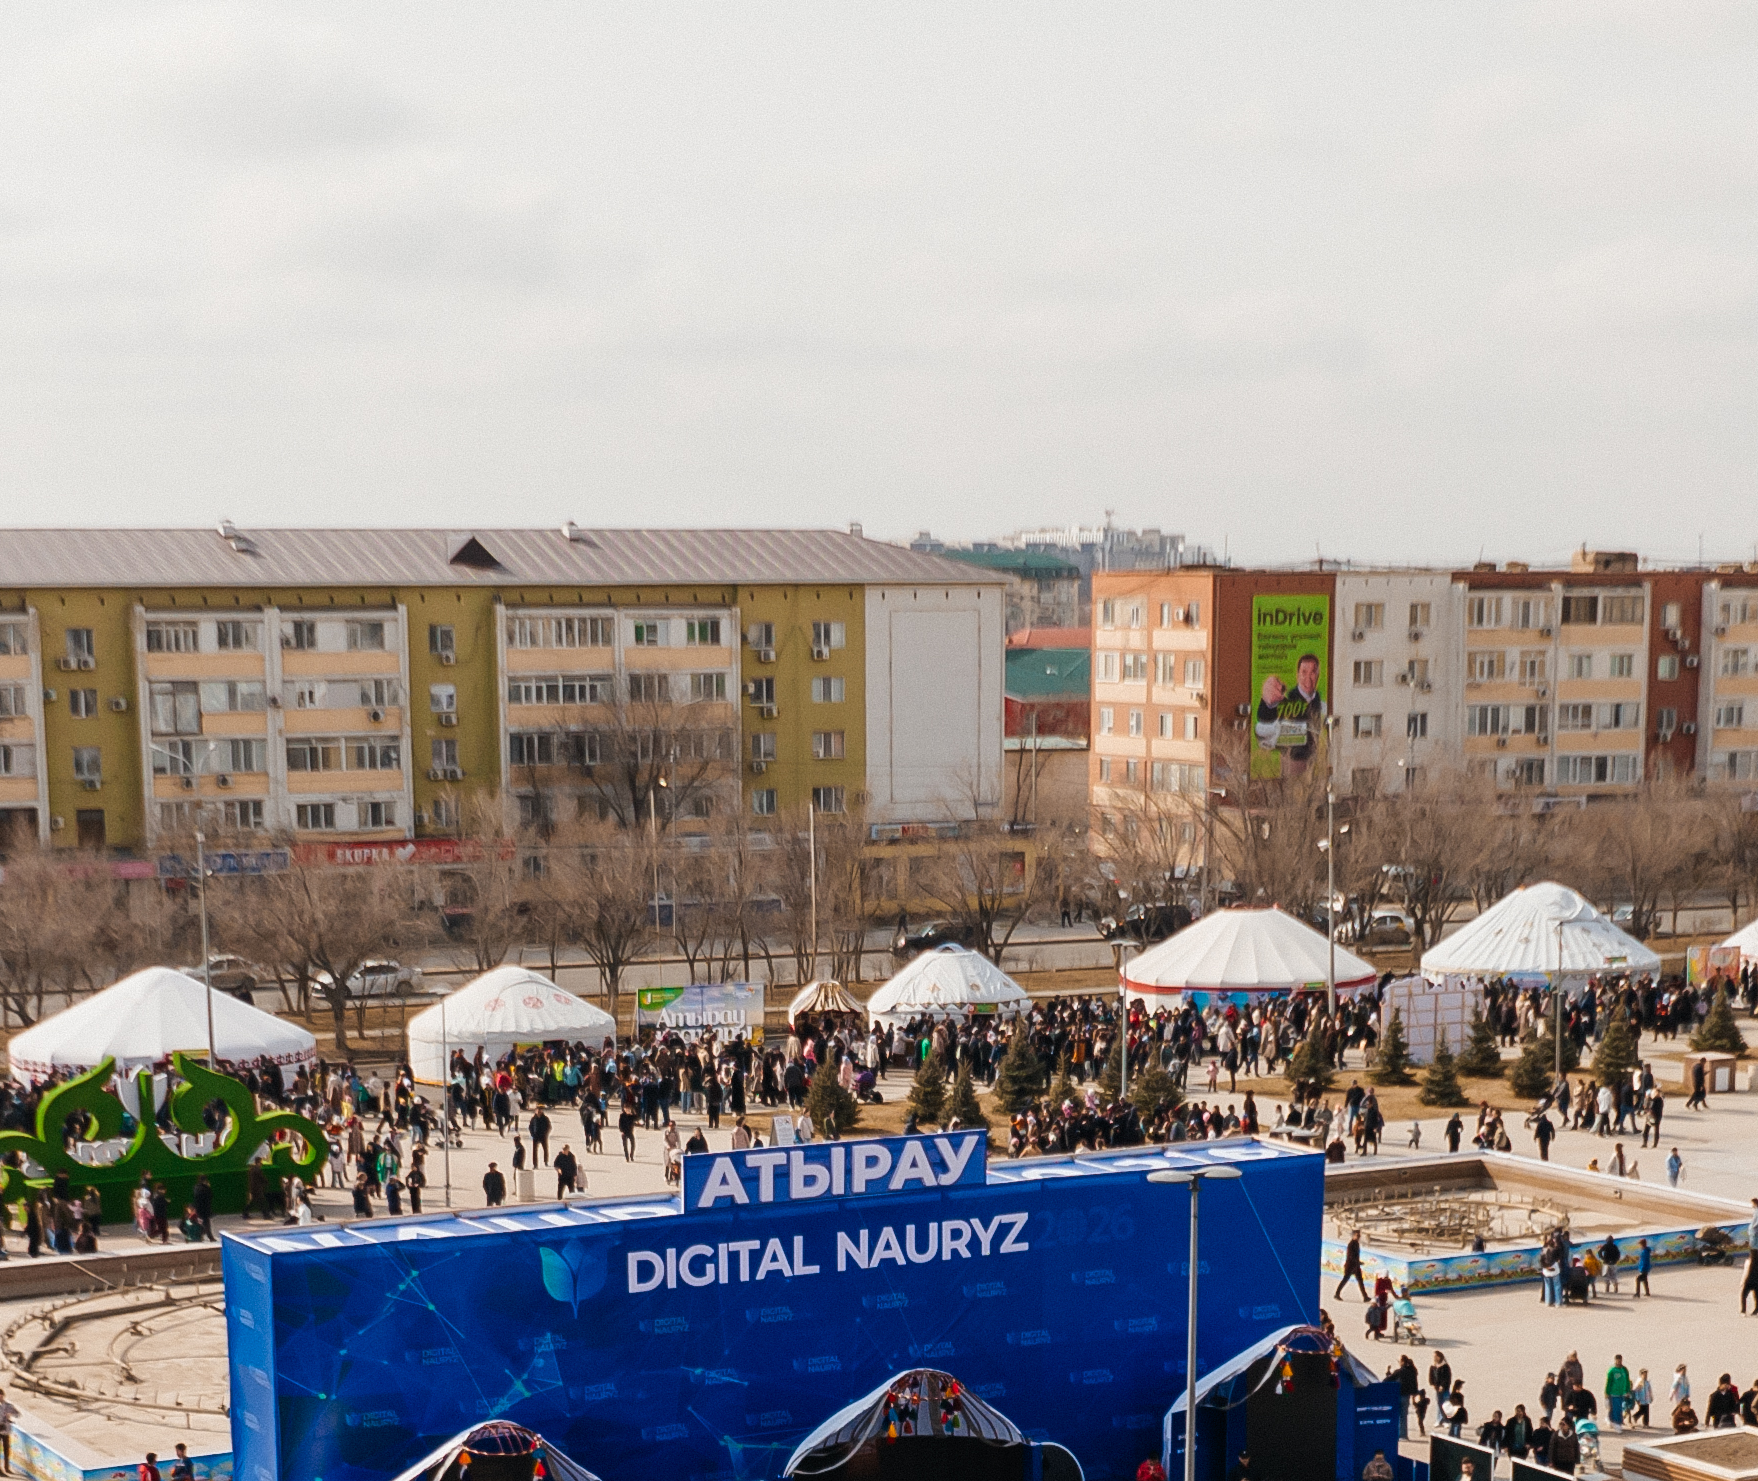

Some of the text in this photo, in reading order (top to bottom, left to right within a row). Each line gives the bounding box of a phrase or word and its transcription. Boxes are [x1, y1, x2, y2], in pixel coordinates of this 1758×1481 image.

[1257, 607, 1323, 627] inDrive
[697, 1135, 980, 1208] АТЫРАУ
[627, 1204, 1135, 1294] DIGITAL NAURYZ 2026
